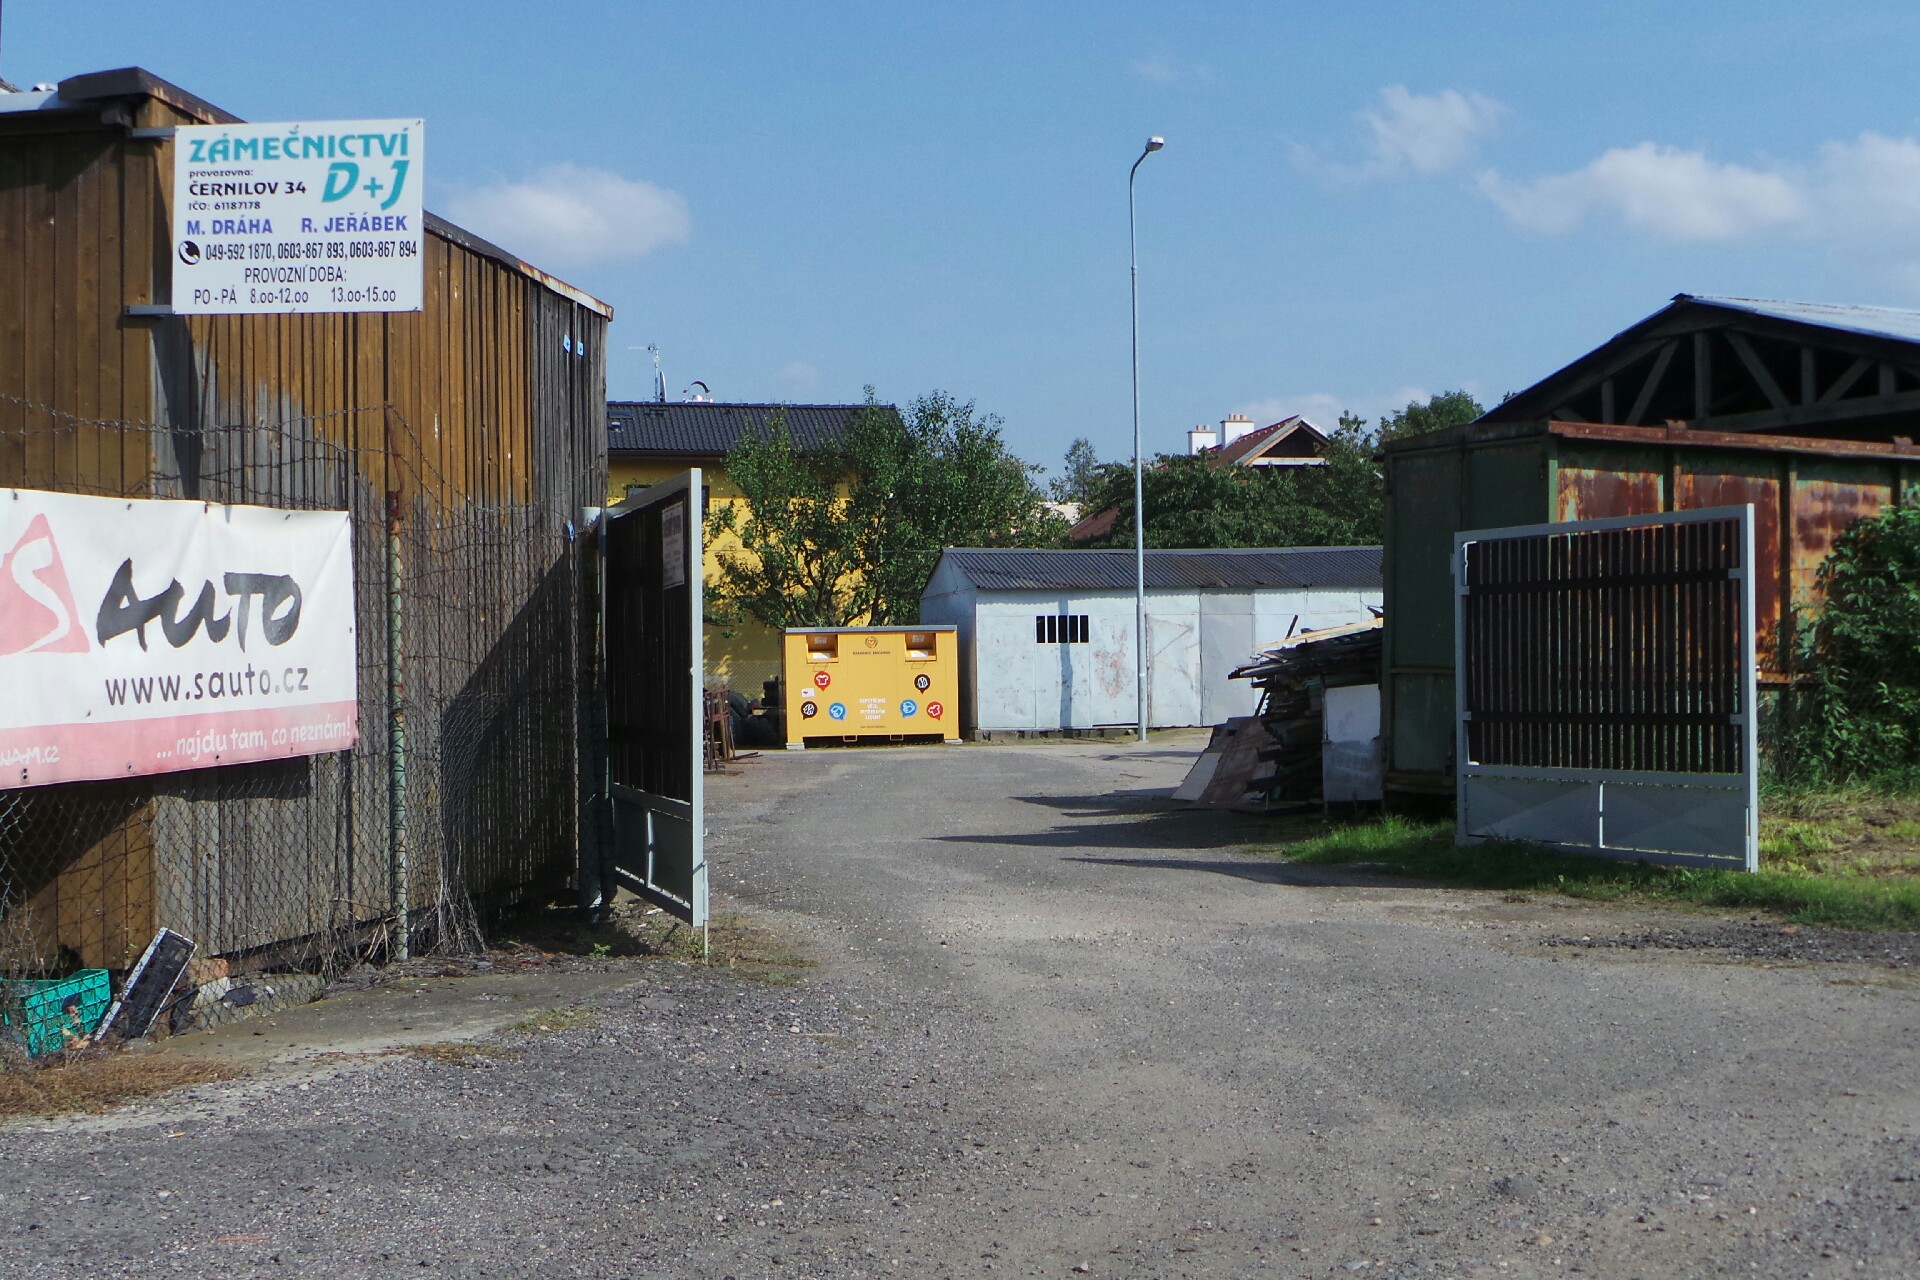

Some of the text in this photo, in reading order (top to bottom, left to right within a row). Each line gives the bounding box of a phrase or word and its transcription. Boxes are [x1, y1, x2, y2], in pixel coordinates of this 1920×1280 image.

[188, 128, 409, 163] ZÁMEČNICTVÍ
[189, 169, 254, 179] provozovna:
[189, 180, 307, 197] ČERNILOV 34
[188, 201, 261, 211] IČO: 61187178
[186, 211, 408, 236] M. DRÁHA R. JEŘÁBEK
[205, 243, 246, 261] 049-592
[248, 243, 276, 262] 1870,
[277, 241, 324, 260] 0603-867
[399, 240, 417, 258] 894
[244, 264, 347, 284] PROVOZNÍ DOBA:
[105, 662, 309, 706] www.sauto.cz
[177, 729, 228, 762] najdu
[230, 727, 268, 752] tam,
[271, 727, 288, 746] co
[290, 713, 351, 743] neznám!
